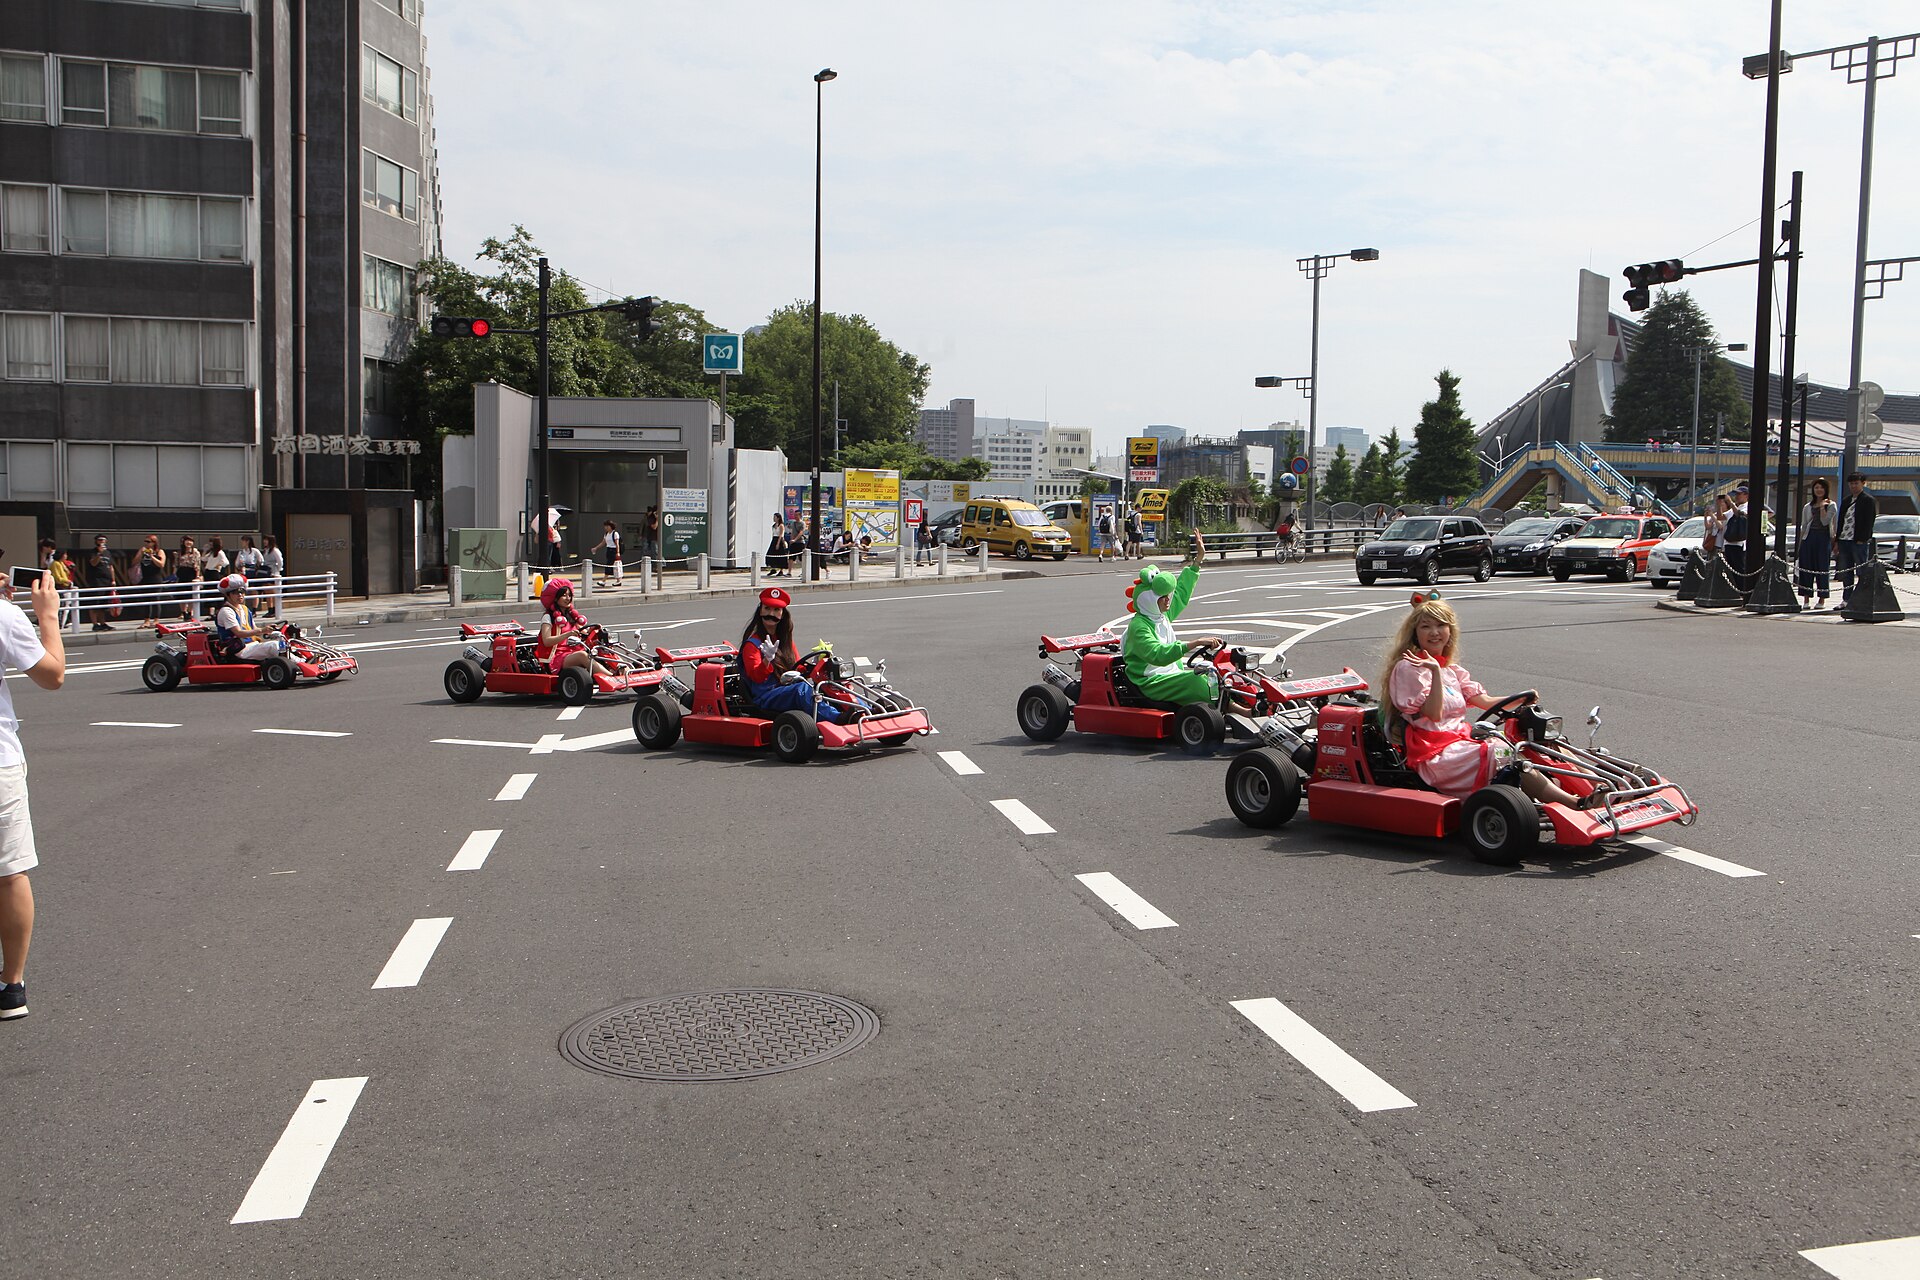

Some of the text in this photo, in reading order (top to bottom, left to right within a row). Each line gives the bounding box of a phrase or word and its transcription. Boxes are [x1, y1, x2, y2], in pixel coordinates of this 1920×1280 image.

[271, 433, 375, 455] 南国酒家
[1146, 455, 1156, 465] P
[1141, 497, 1163, 507] Times
